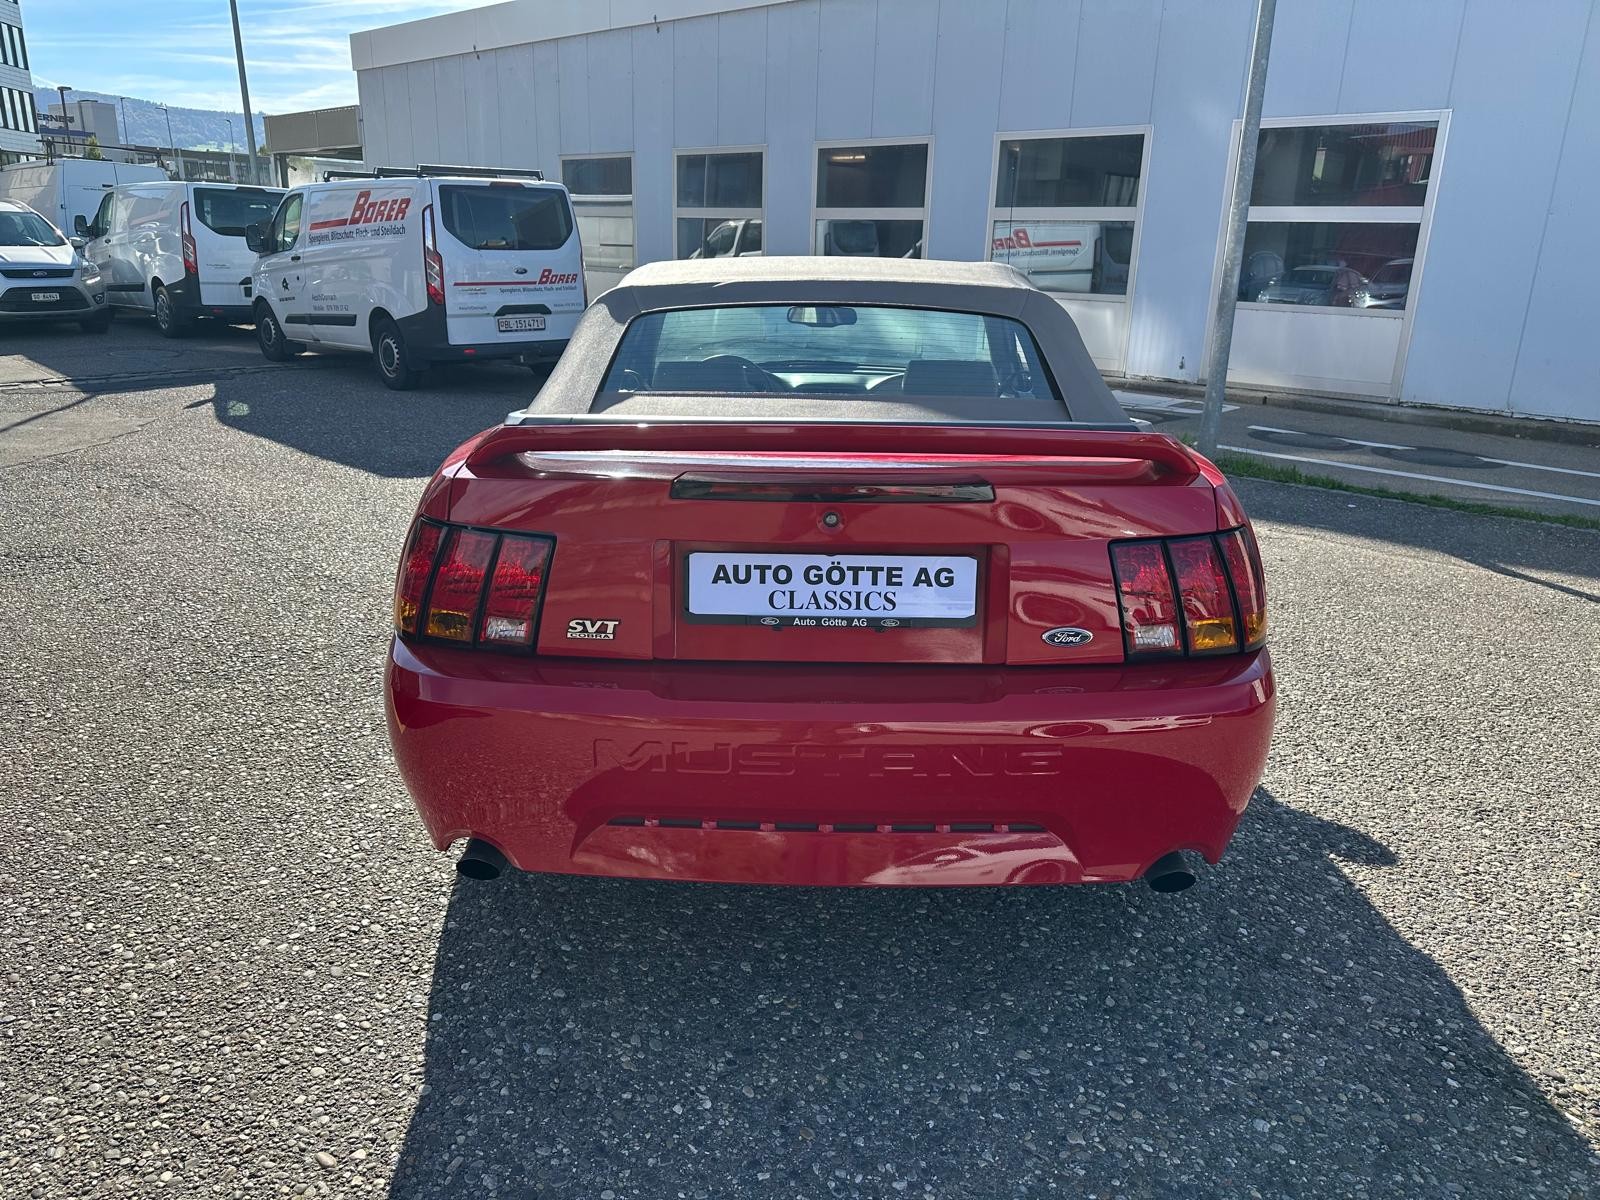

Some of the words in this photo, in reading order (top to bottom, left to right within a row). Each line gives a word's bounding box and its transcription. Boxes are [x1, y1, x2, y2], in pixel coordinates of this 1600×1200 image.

[349, 190, 411, 225] BORER
[381, 224, 405, 236] Steildach
[538, 269, 578, 284] BORER
[711, 564, 793, 585] AUTO
[803, 562, 903, 586] GÖTTE
[912, 567, 955, 587] AG
[768, 589, 897, 612] CLASSICS
[568, 619, 619, 634] SVT
[793, 617, 816, 626] Auto
[821, 617, 847, 627] Götte
[852, 618, 867, 627] AG
[593, 737, 1063, 776] MUSTANG
